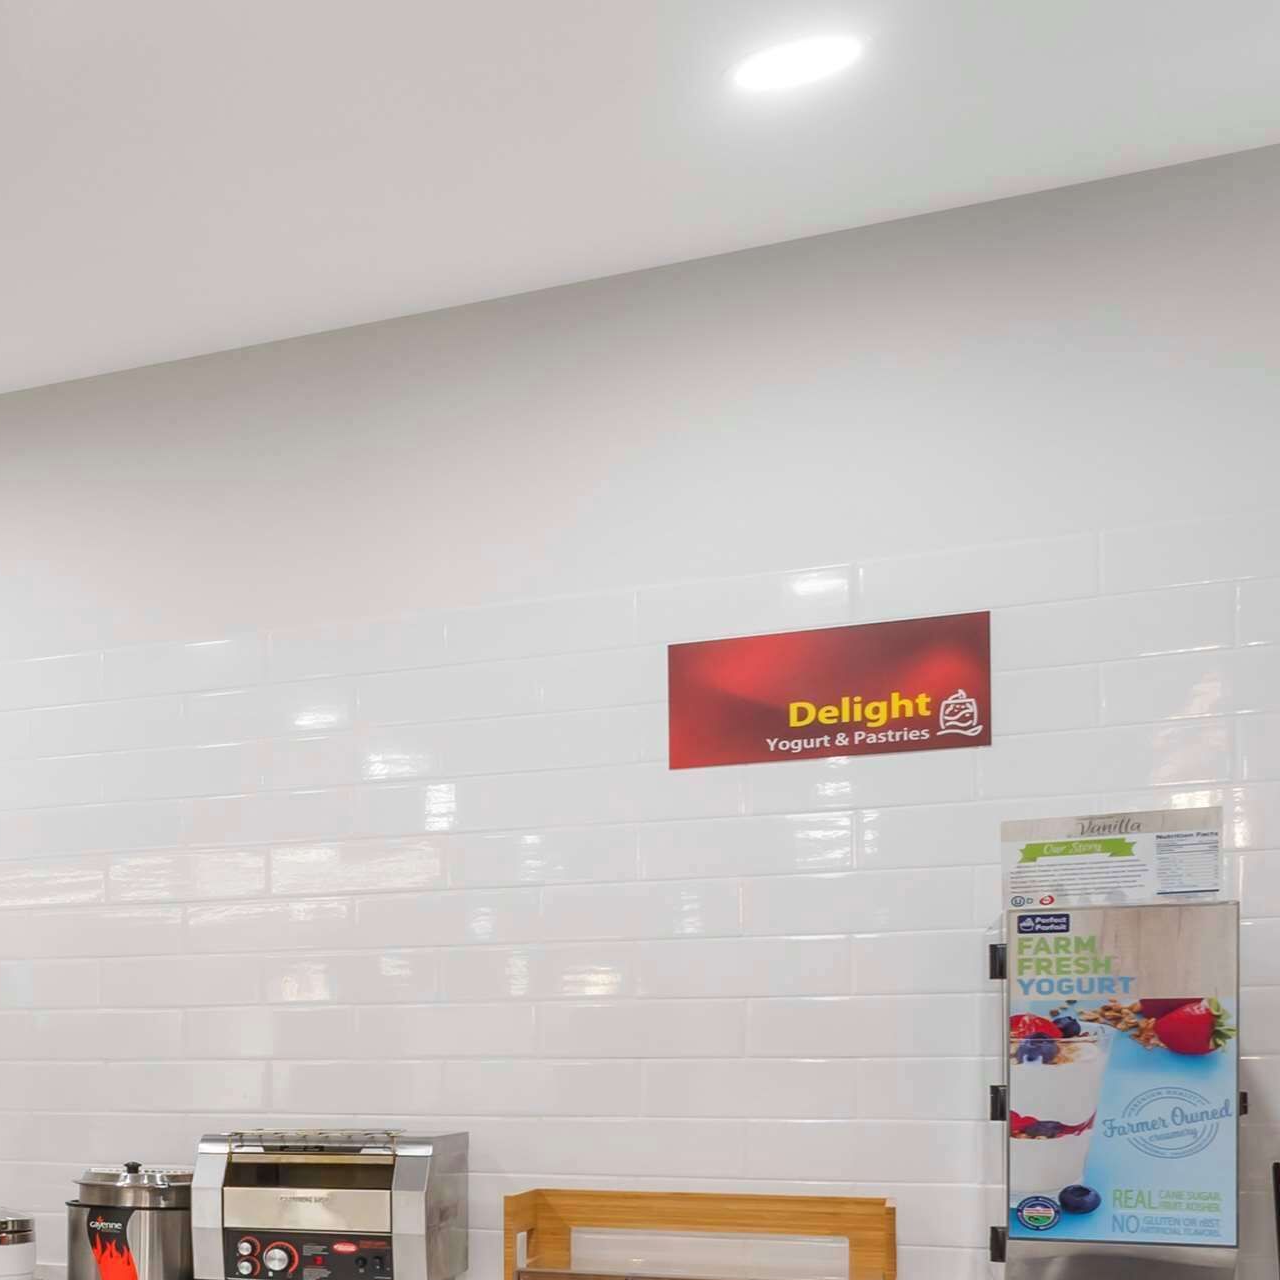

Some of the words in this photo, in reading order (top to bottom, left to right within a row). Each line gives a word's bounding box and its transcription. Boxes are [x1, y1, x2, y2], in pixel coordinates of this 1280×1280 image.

[788, 691, 932, 728] Delight
[767, 734, 831, 754] Yogurt
[834, 732, 849, 746] &
[853, 726, 930, 746] Pastries
[1077, 817, 1141, 836] Vanilla
[1017, 936, 1096, 955] FARM
[1017, 956, 1114, 976] FRESH
[1017, 976, 1135, 996] YOGURT
[1102, 1117, 1169, 1138] Farmer
[1171, 1098, 1232, 1126] Owned
[1112, 1189, 1158, 1209] REAL
[1112, 1214, 1140, 1234] NO
